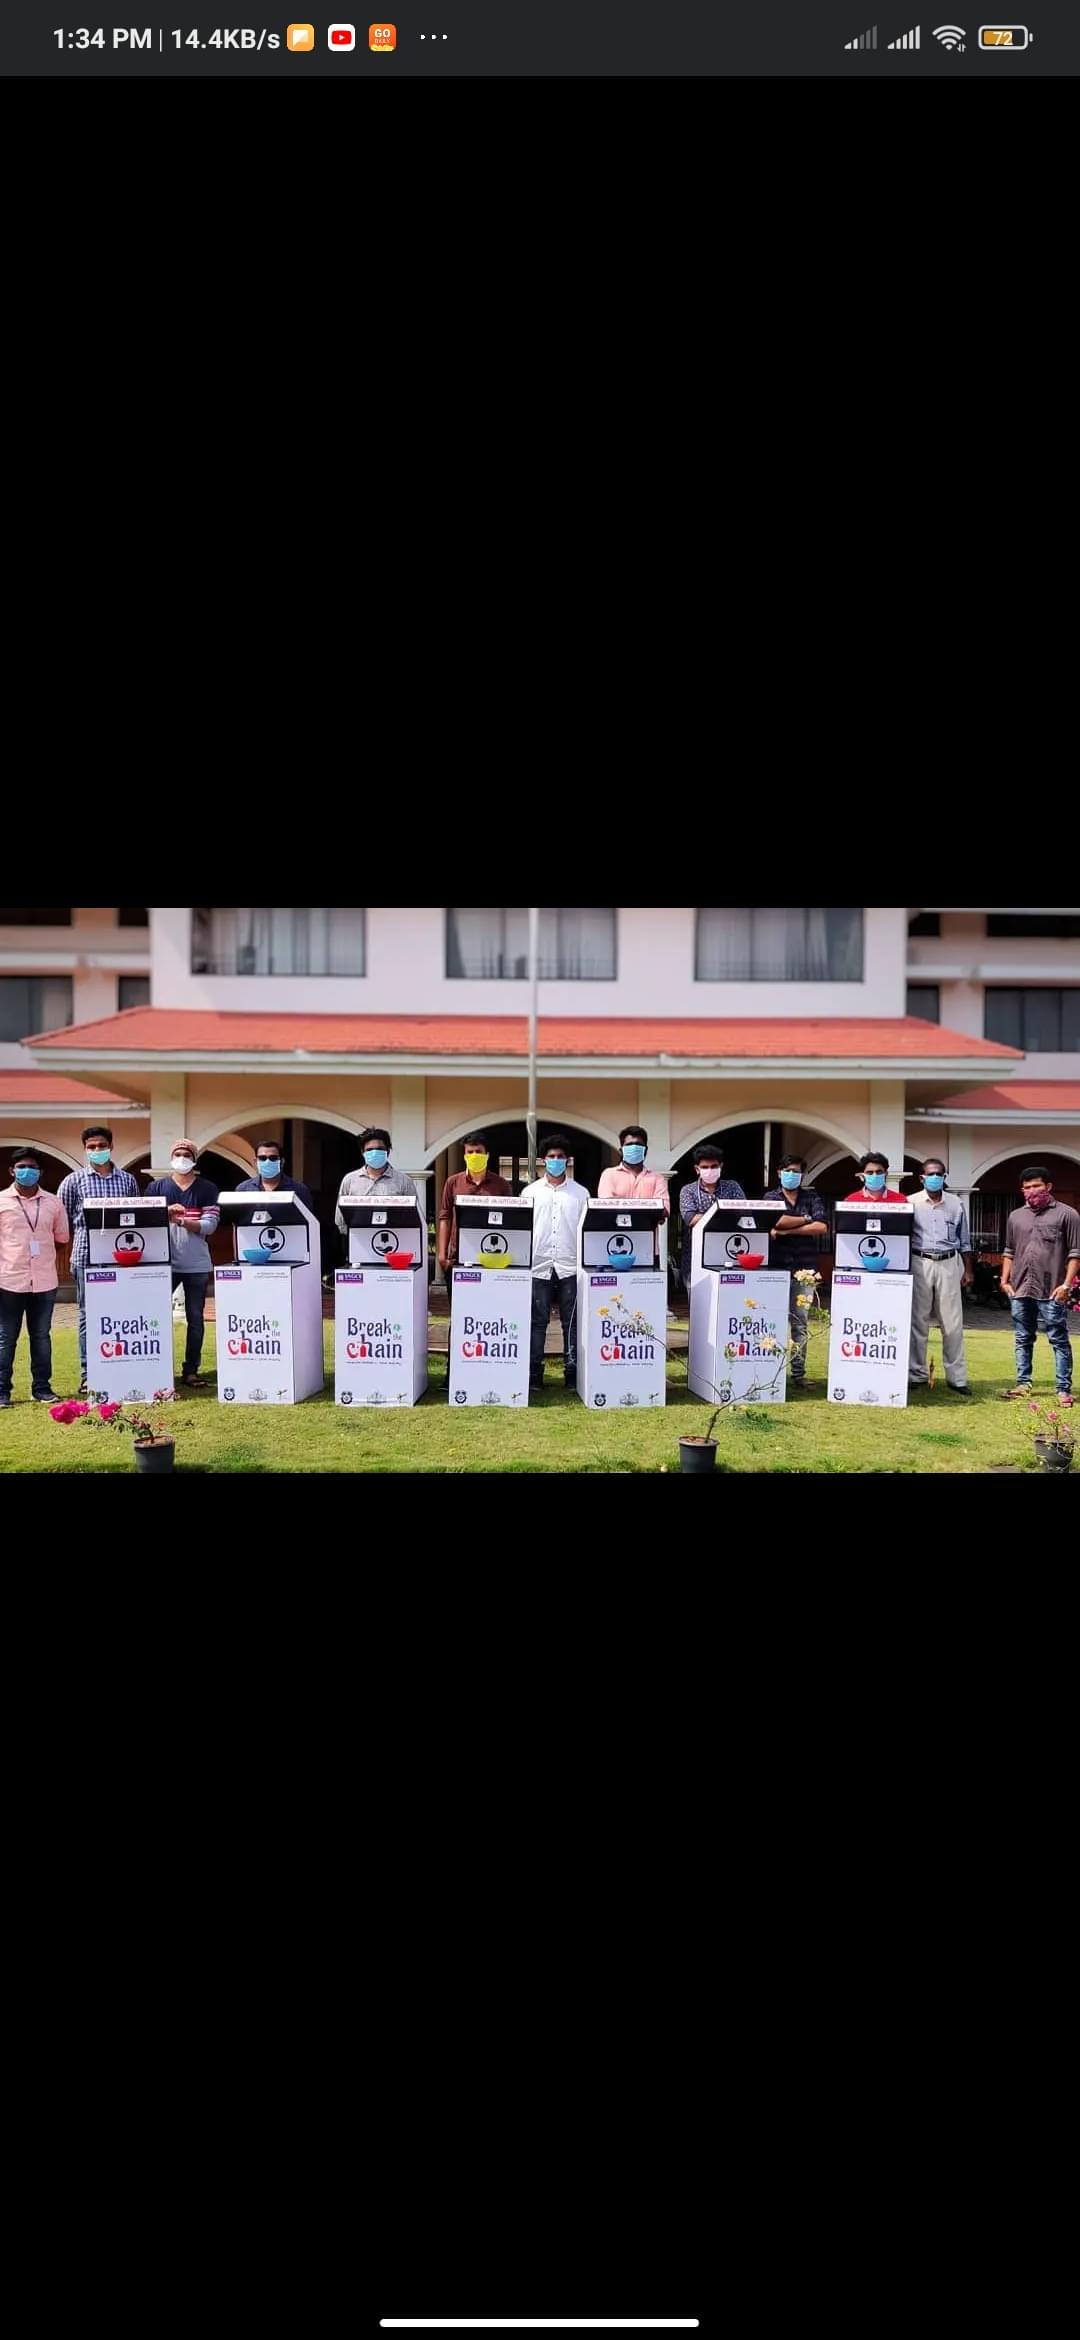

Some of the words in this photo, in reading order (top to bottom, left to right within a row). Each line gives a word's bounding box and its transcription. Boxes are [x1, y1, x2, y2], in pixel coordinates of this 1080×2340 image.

[101, 1316, 150, 1335] Break
[228, 1314, 271, 1333] Break
[348, 1318, 392, 1336] Break
[464, 1316, 508, 1336] Break
[728, 1318, 768, 1336] Break
[843, 1318, 888, 1337] Break
[100, 1332, 160, 1357] chain
[228, 1330, 281, 1355] chain
[346, 1334, 402, 1358] chain
[462, 1333, 518, 1358] chain
[600, 1337, 654, 1361] chain
[841, 1334, 897, 1360] chain
